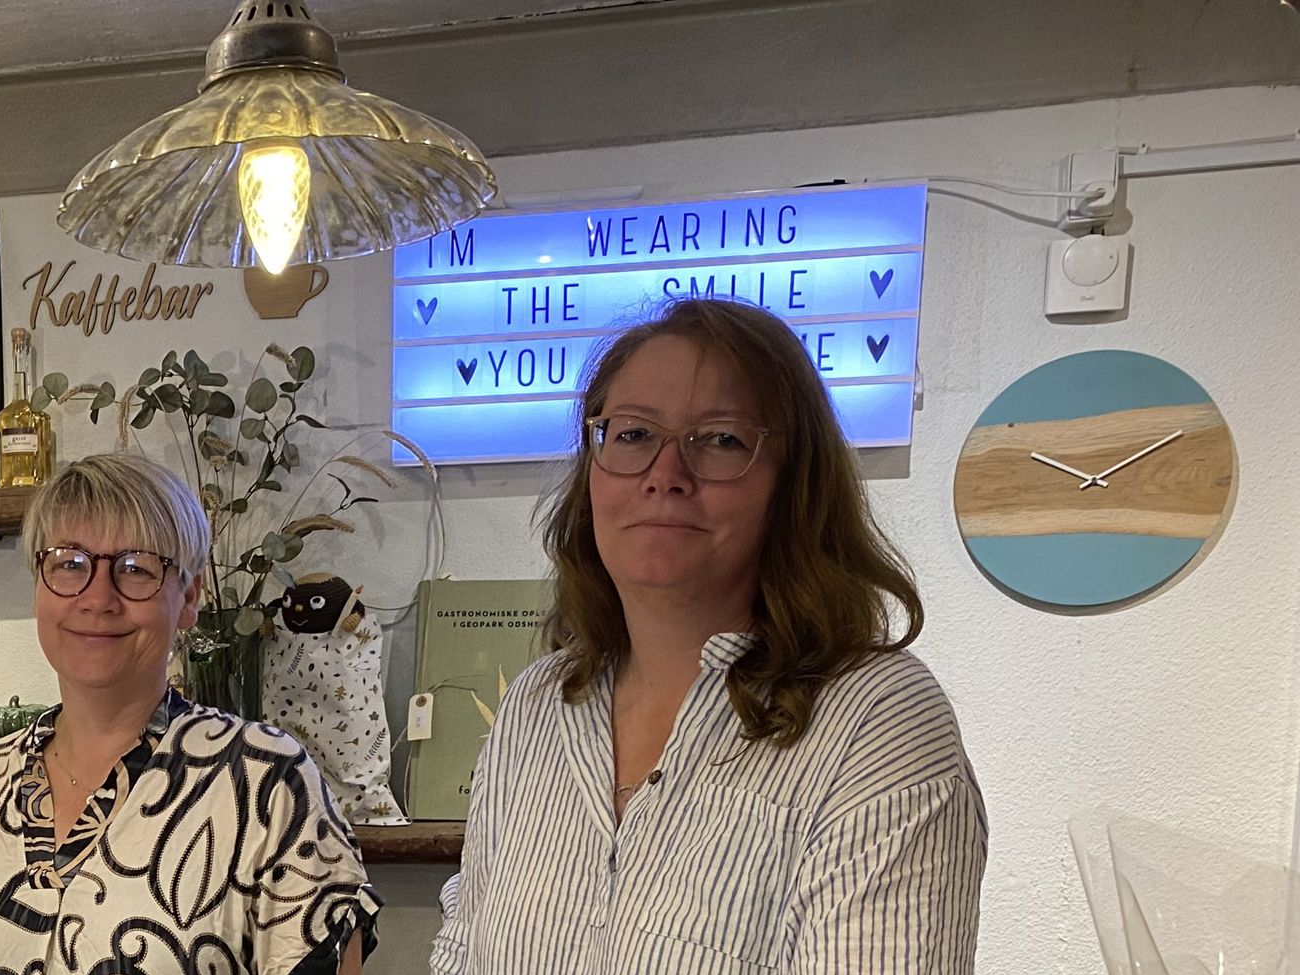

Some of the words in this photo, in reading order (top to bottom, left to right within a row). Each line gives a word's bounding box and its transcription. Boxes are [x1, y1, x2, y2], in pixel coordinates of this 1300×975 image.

[587, 205, 798, 257] WEARING
[22, 260, 214, 337] Kaffebar
[501, 283, 580, 326] THE
[488, 347, 566, 388] YOU
[436, 610, 519, 618] GASTRONOMISKE
